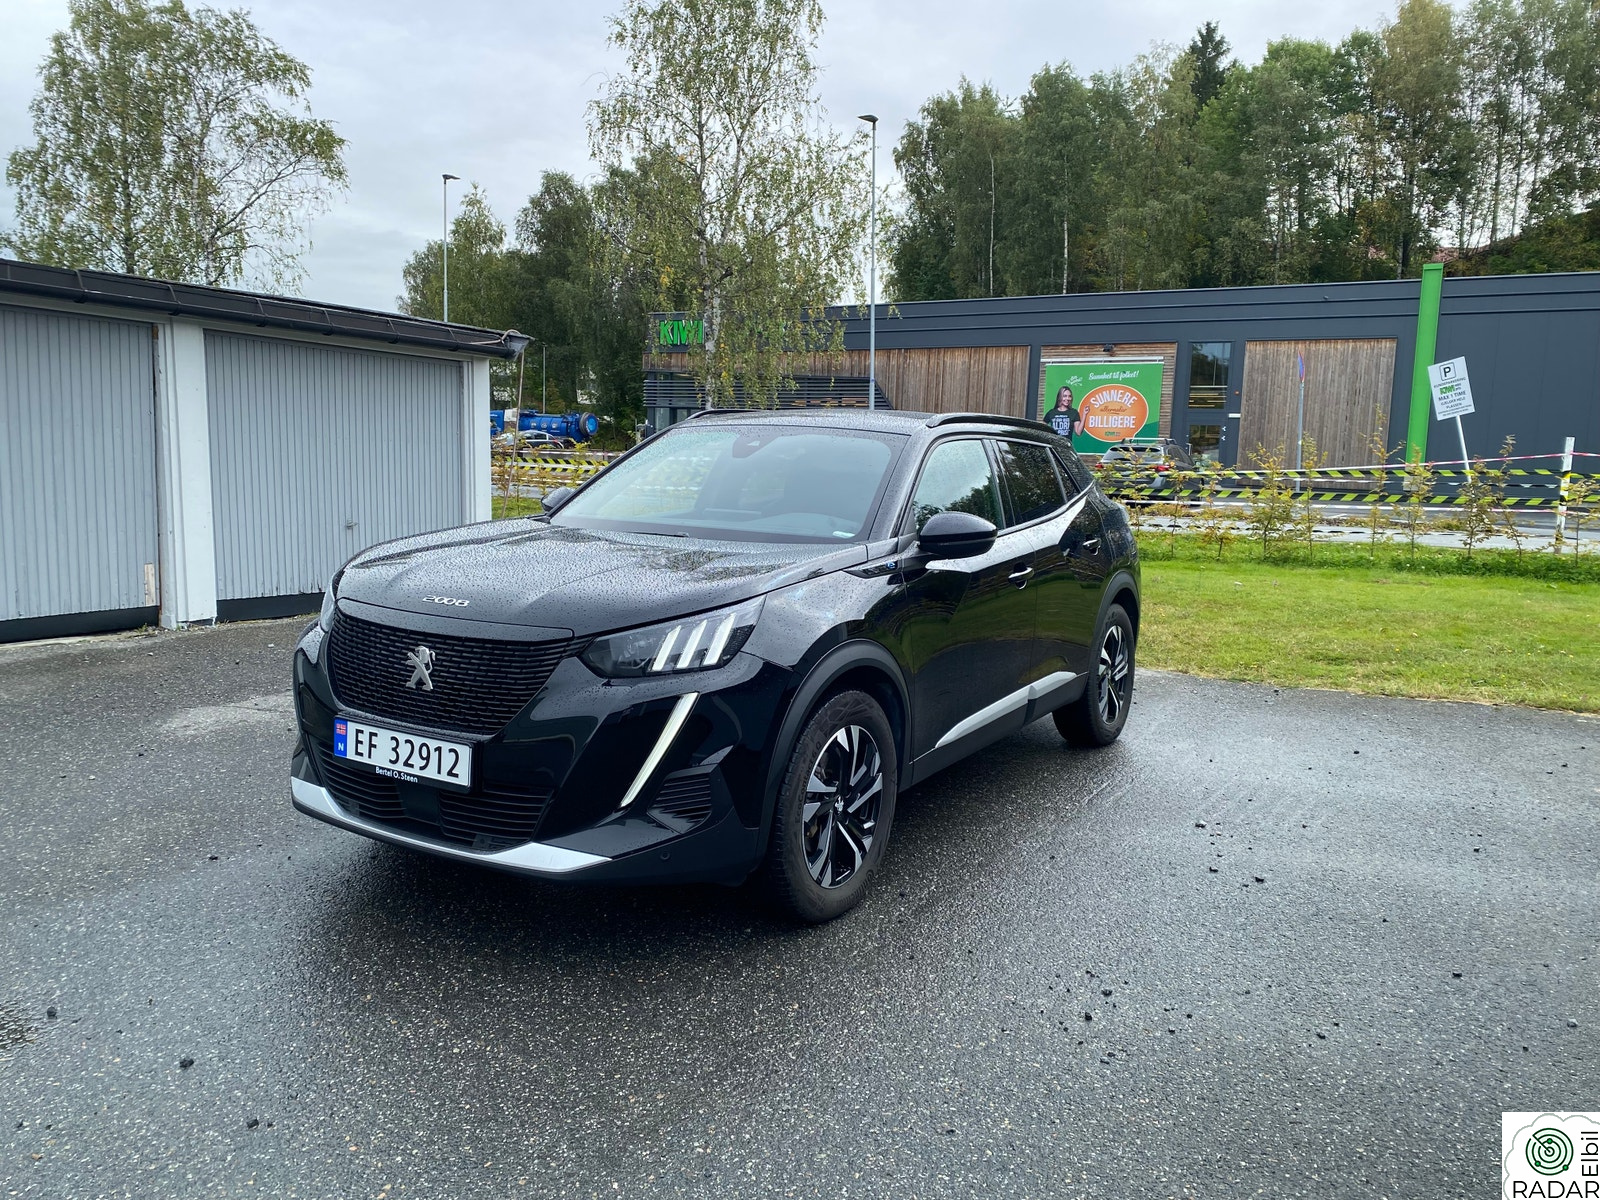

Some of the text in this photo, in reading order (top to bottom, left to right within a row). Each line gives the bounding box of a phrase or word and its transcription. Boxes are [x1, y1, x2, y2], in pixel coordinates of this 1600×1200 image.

[660, 320, 704, 345] KIWI
[1443, 366, 1451, 378] P
[1090, 389, 1137, 408] SUNNERE
[1089, 415, 1136, 428] BILLIGERE
[422, 594, 470, 607] 2008
[338, 742, 344, 751] N
[355, 728, 460, 778] EF 32912
[375, 766, 418, 783] Bertel O. Steen
